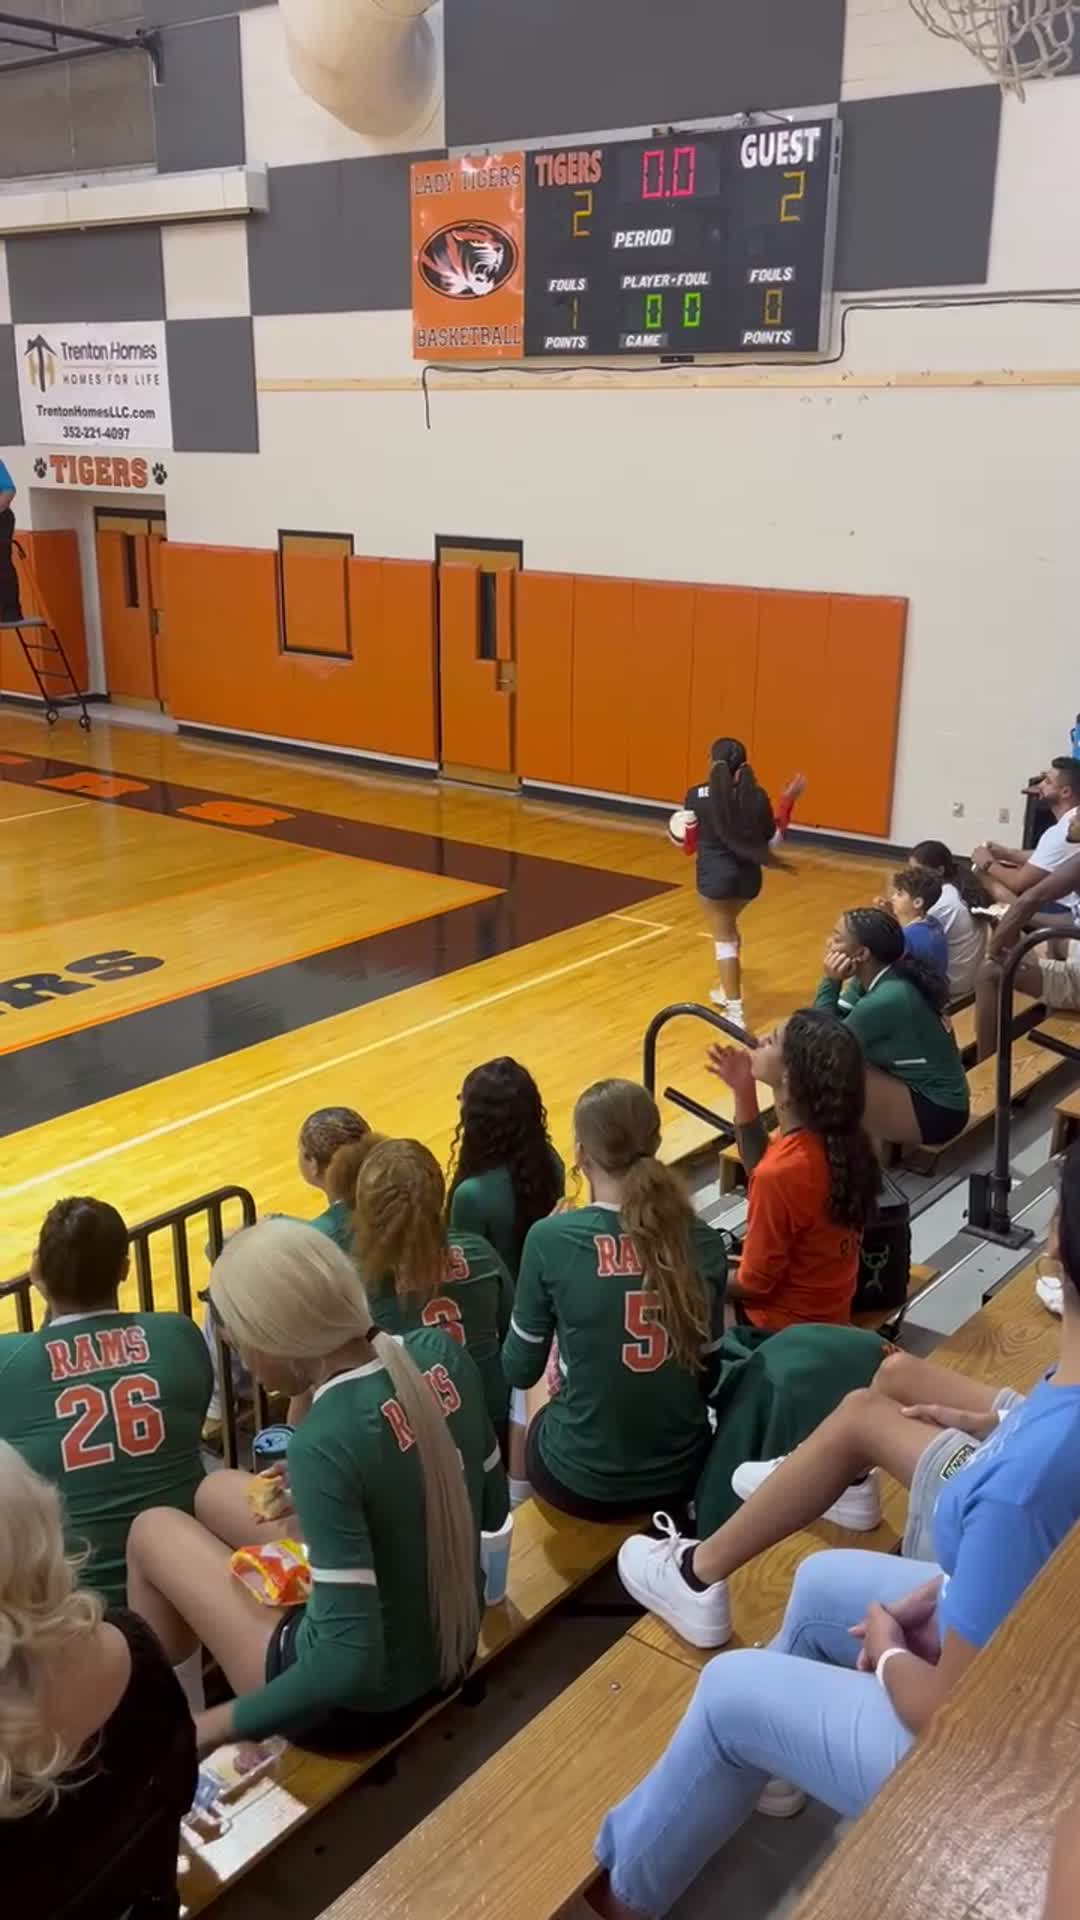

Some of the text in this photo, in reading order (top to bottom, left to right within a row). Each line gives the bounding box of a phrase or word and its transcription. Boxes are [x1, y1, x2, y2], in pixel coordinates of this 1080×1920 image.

[740, 127, 821, 169] GUEST
[415, 164, 521, 195] LADY TIGERS
[534, 150, 603, 186] TIGERS
[642, 145, 695, 198] 0.0
[780, 170, 805, 223] 2
[573, 189, 592, 237] 2
[613, 228, 672, 249] PERIOD
[549, 278, 586, 292] FOULS
[750, 266, 793, 283] FOULS
[646, 292, 700, 328] 0 0
[415, 325, 522, 348] BASKETBALL
[545, 336, 587, 349] POINTS
[625, 334, 662, 347] GAME
[743, 329, 793, 345] POINTS
[60, 341, 158, 361] Trenton Homes
[63, 373, 160, 386] HOMES FOR LIFE
[36, 404, 156, 419] TrentonHomesLLC.com
[62, 426, 131, 440] 352-221-4097
[49, 454, 149, 488] TIGERS
[622, 1290, 669, 1372] 5
[45, 1325, 150, 1381] RAMS
[55, 1373, 165, 1472] 26
